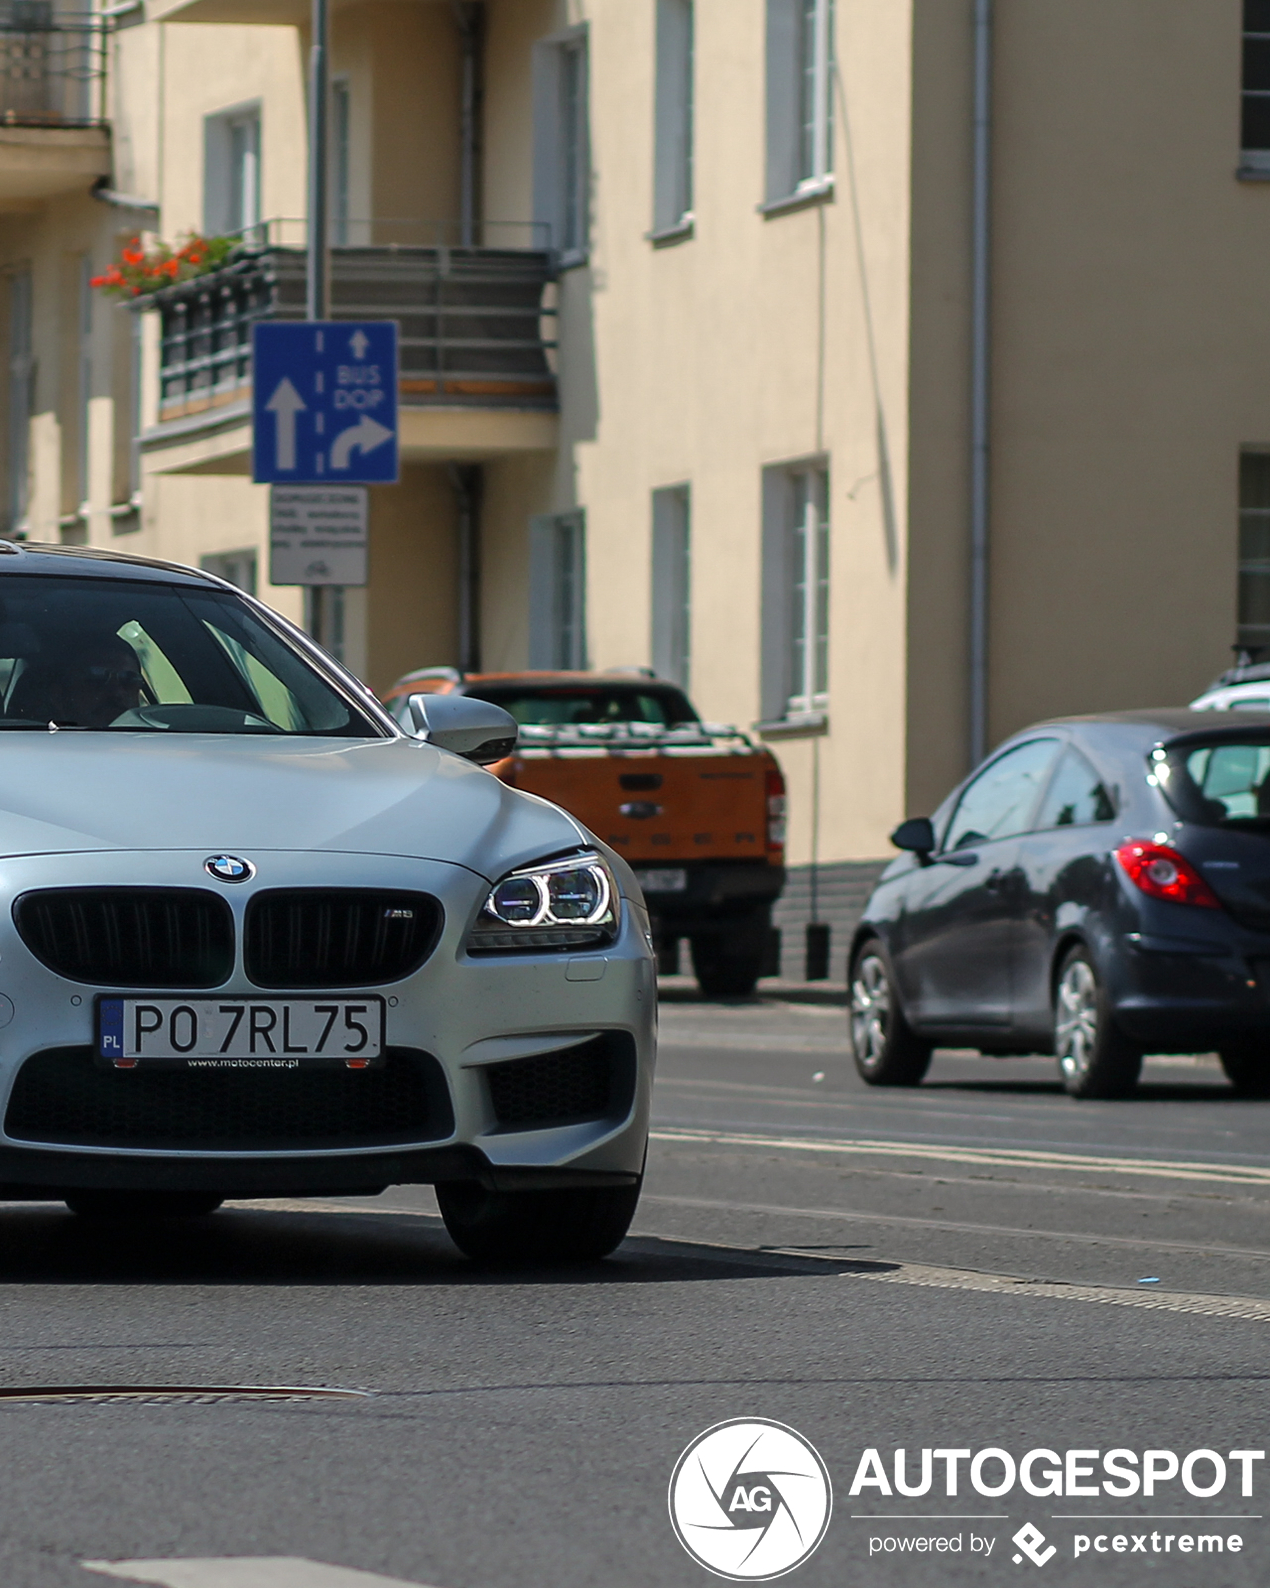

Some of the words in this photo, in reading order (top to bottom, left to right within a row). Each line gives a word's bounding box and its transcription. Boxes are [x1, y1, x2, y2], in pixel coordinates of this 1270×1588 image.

[336, 365, 381, 385] BUS
[334, 390, 385, 409] DOP
[135, 1005, 198, 1053] PO
[219, 1005, 369, 1053] 7RL75
[103, 1036, 120, 1048] PL
[187, 1059, 299, 1069] www.motocenter.pl
